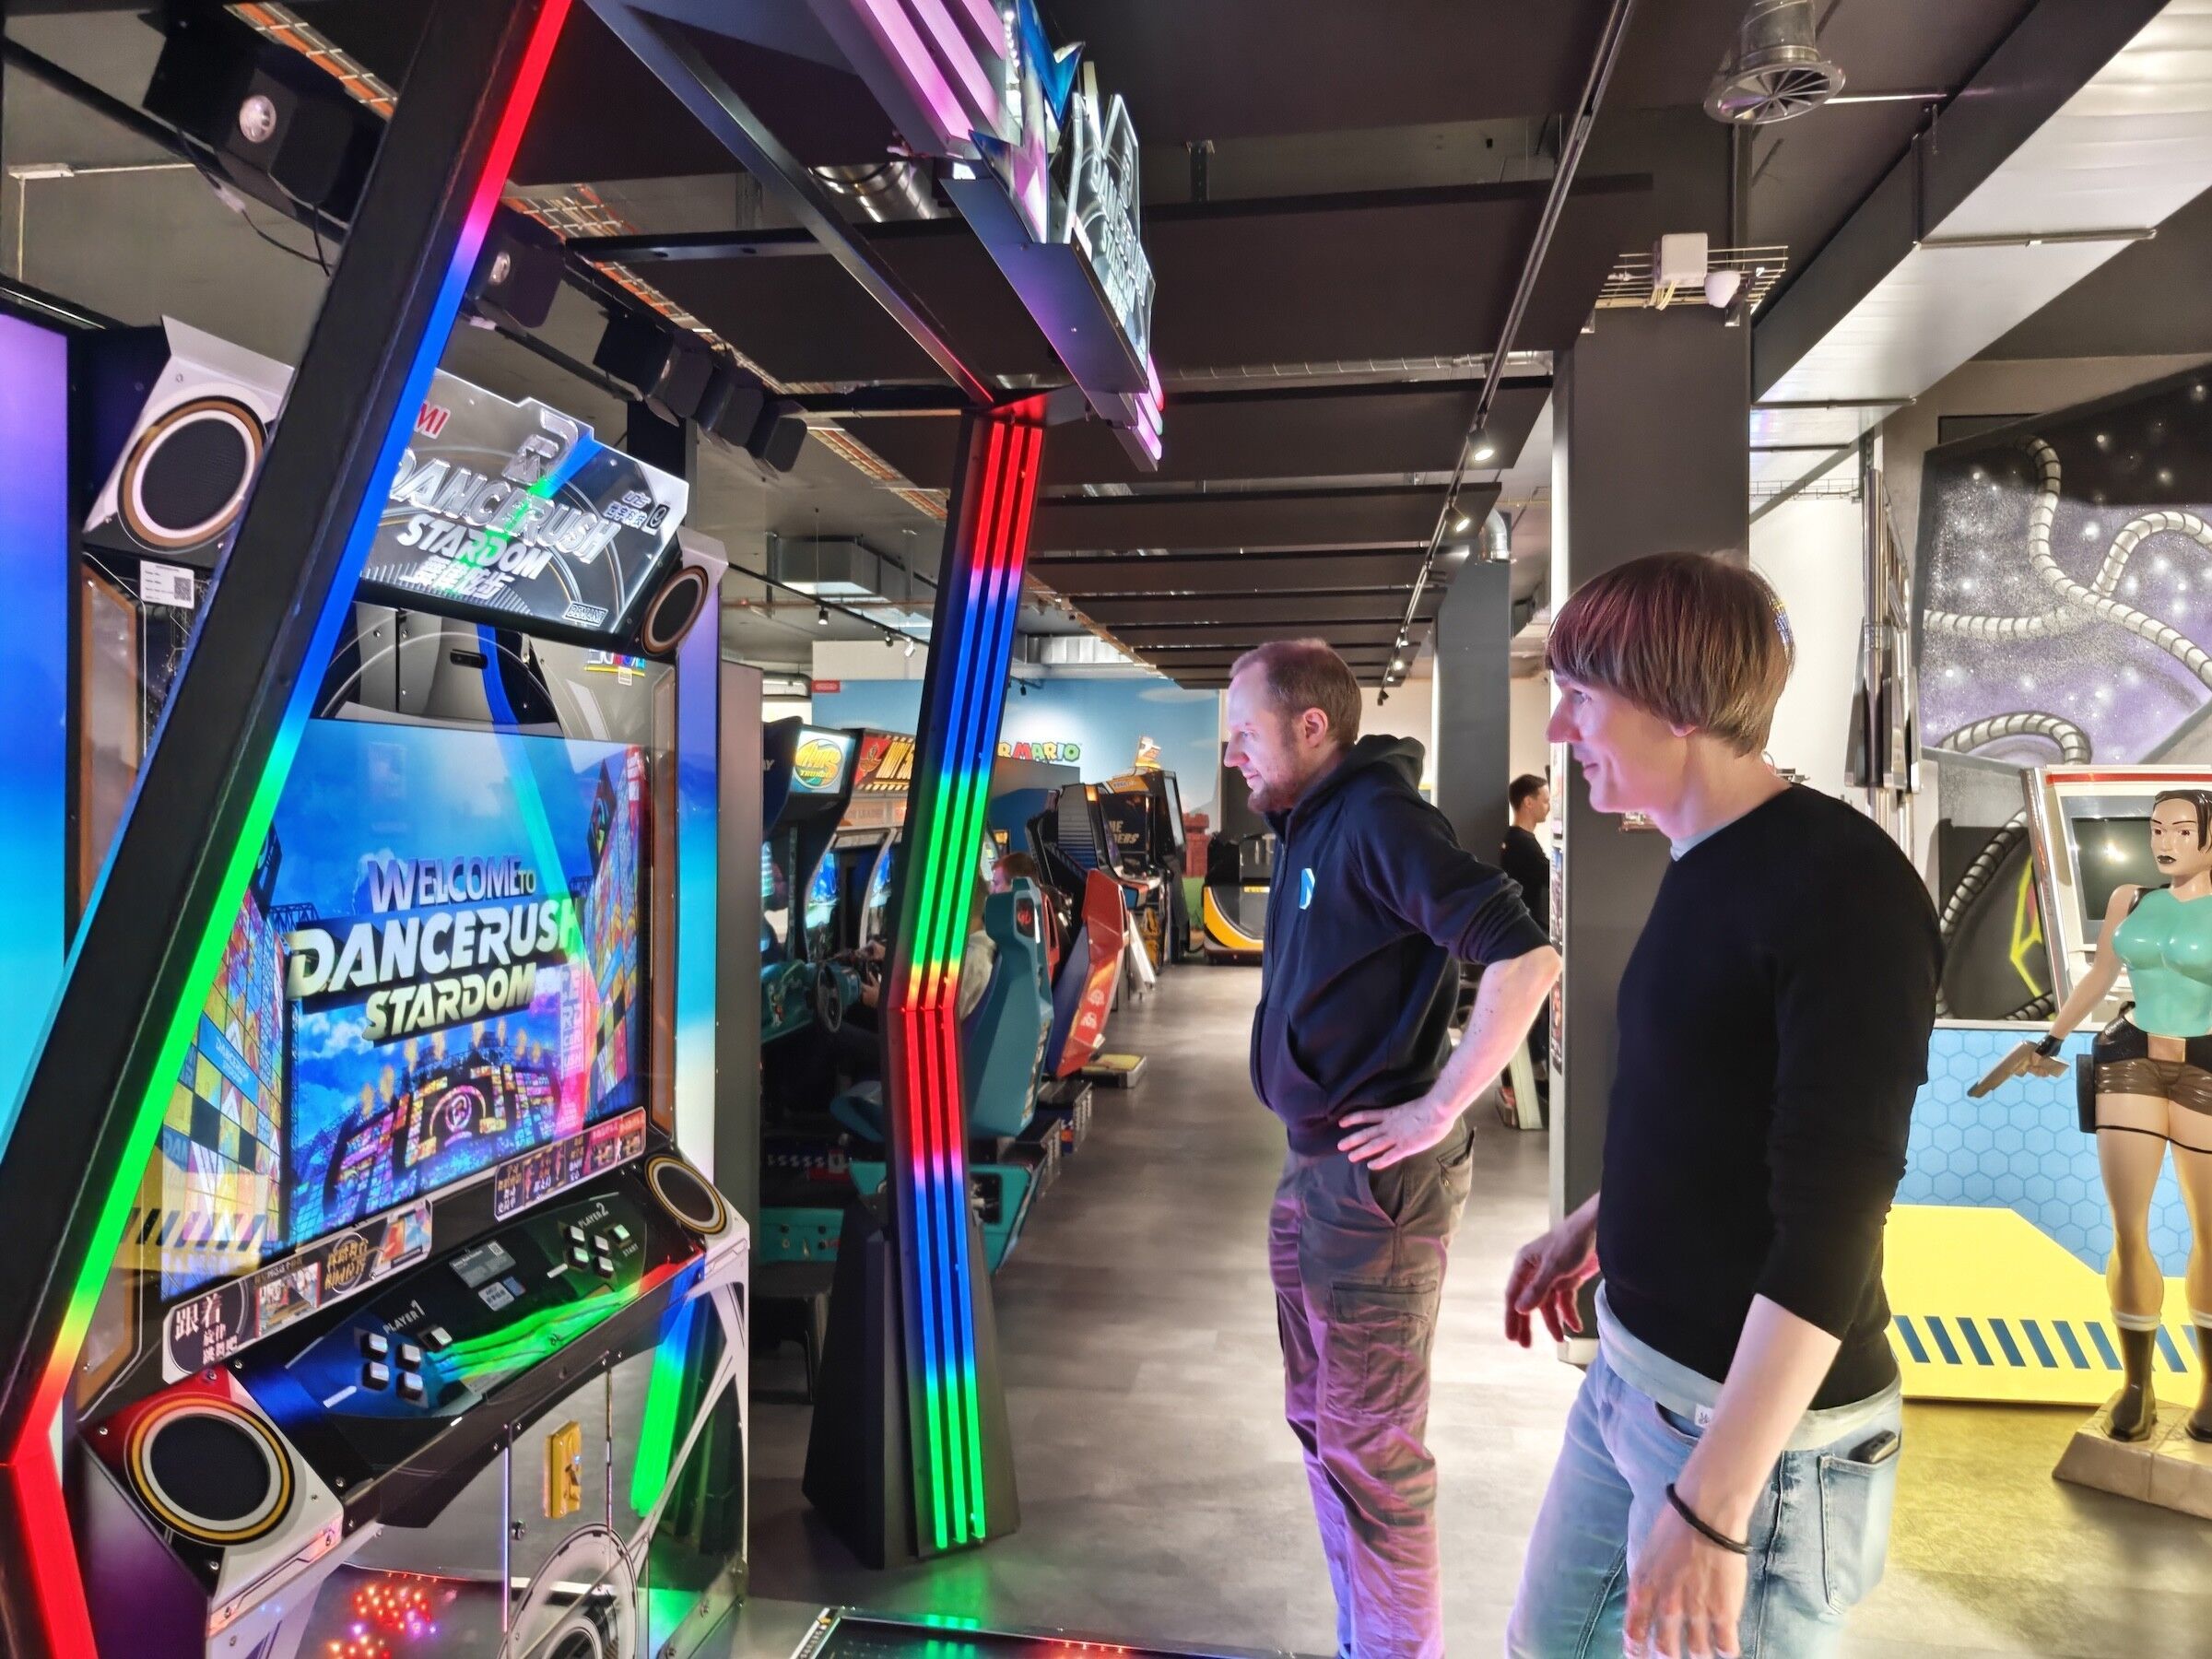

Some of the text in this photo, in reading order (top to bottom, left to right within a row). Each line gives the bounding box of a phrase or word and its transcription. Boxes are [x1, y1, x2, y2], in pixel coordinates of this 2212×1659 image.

[396, 513, 554, 580] STARDOM
[1012, 741, 1081, 763] MARIO
[369, 854, 536, 914] WELCOME TO
[284, 898, 582, 1001] DANCERUSH
[362, 962, 538, 1041] STARDOM
